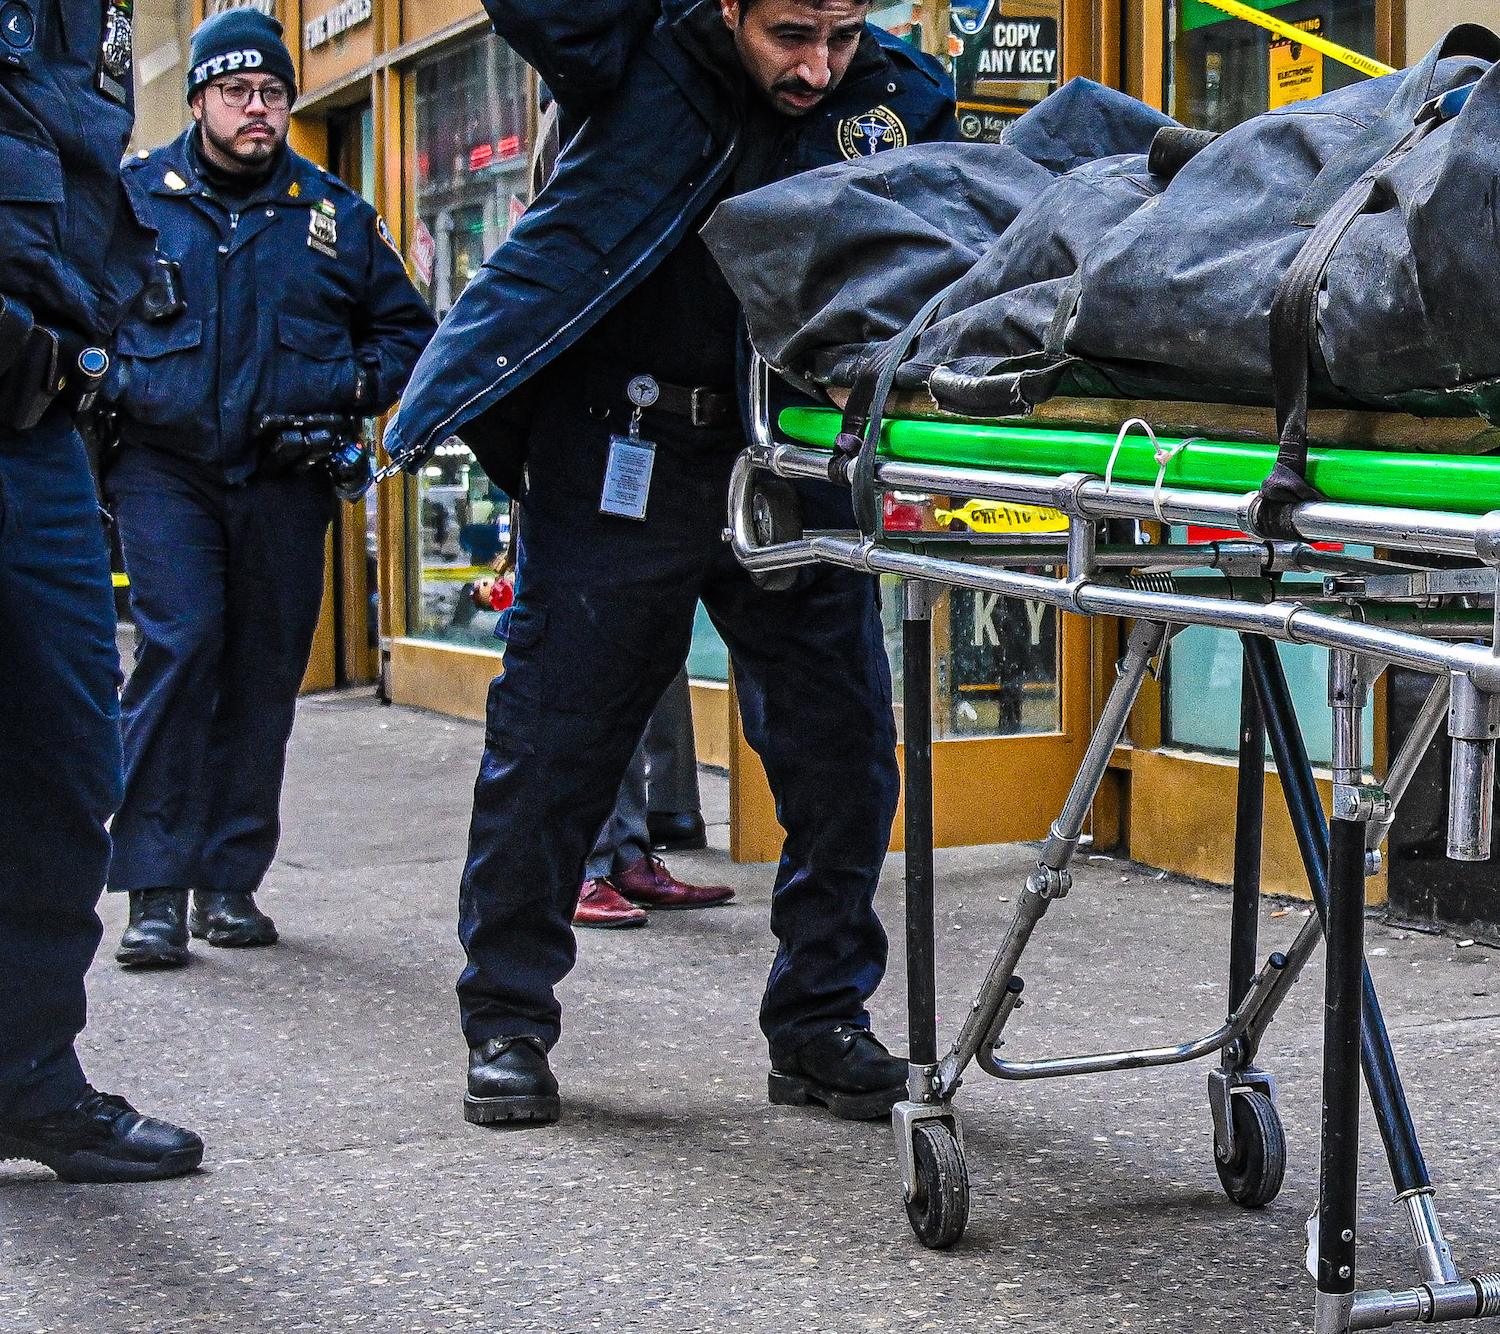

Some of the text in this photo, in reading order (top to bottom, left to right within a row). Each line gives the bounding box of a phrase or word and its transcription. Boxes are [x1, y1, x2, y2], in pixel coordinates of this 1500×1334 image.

[994, 23, 1041, 48] COPY
[194, 48, 263, 84] NYPD
[978, 49, 1056, 74] ANY KEY
